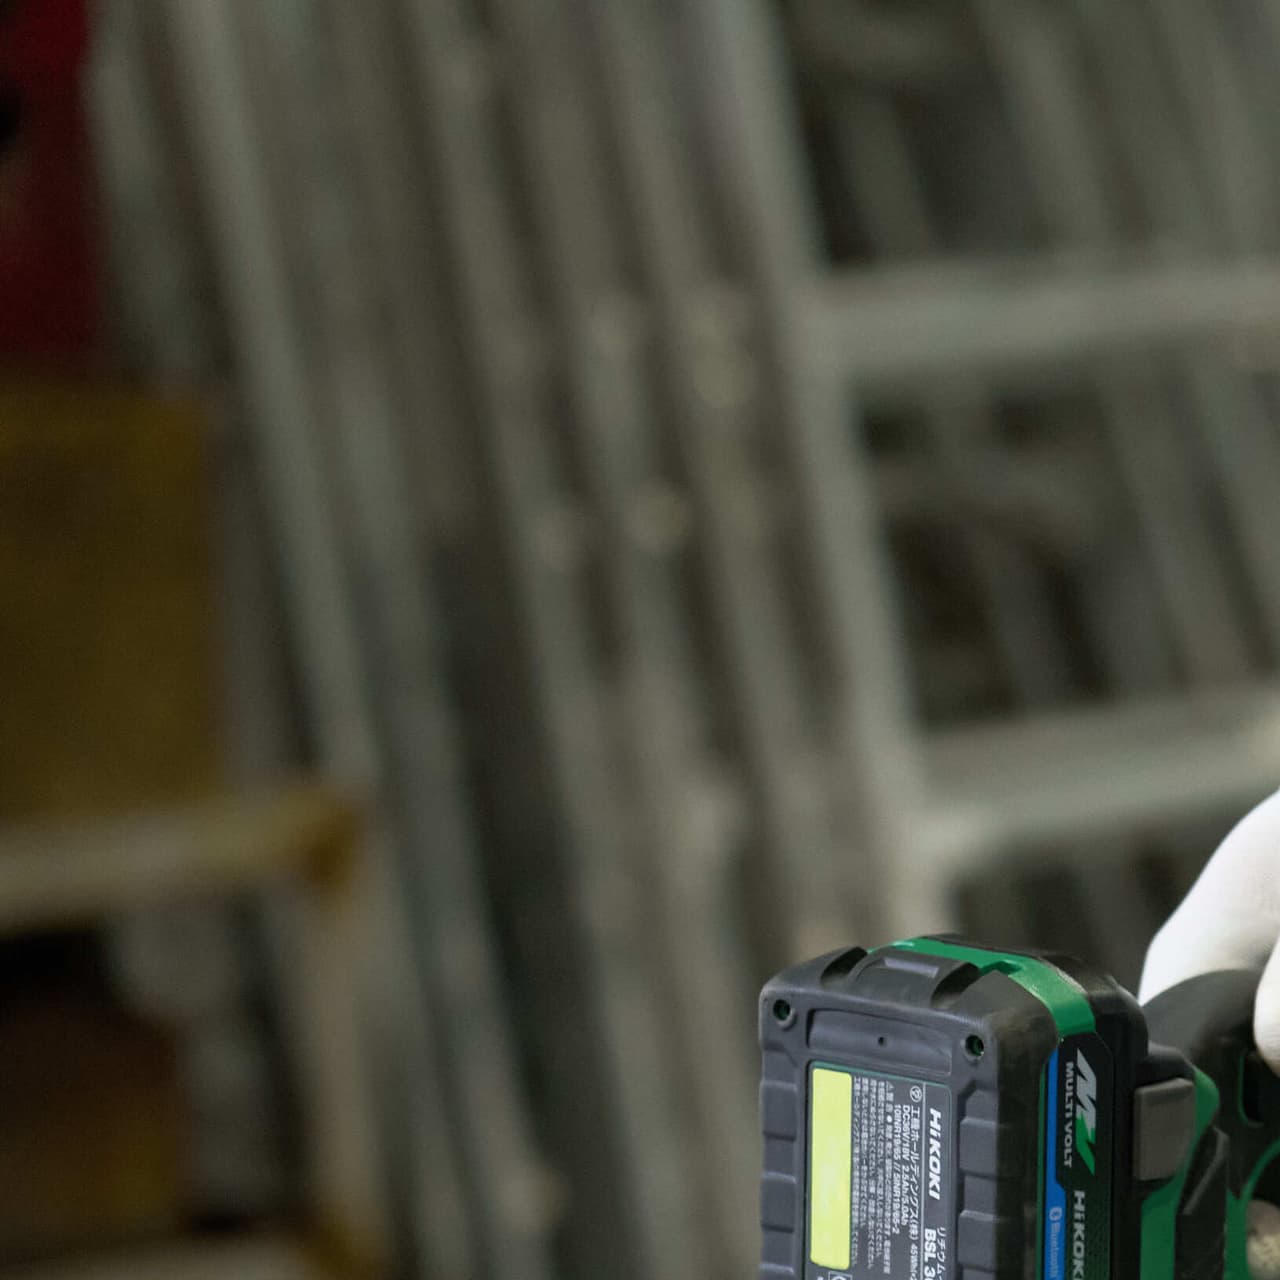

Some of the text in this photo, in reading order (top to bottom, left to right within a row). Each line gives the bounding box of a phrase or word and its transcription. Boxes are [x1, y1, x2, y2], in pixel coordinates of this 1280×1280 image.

[928, 1107, 942, 1201] HiKOKI
[1063, 1061, 1074, 1168] MULTI VOLT
[923, 1228, 937, 1262] BSL
